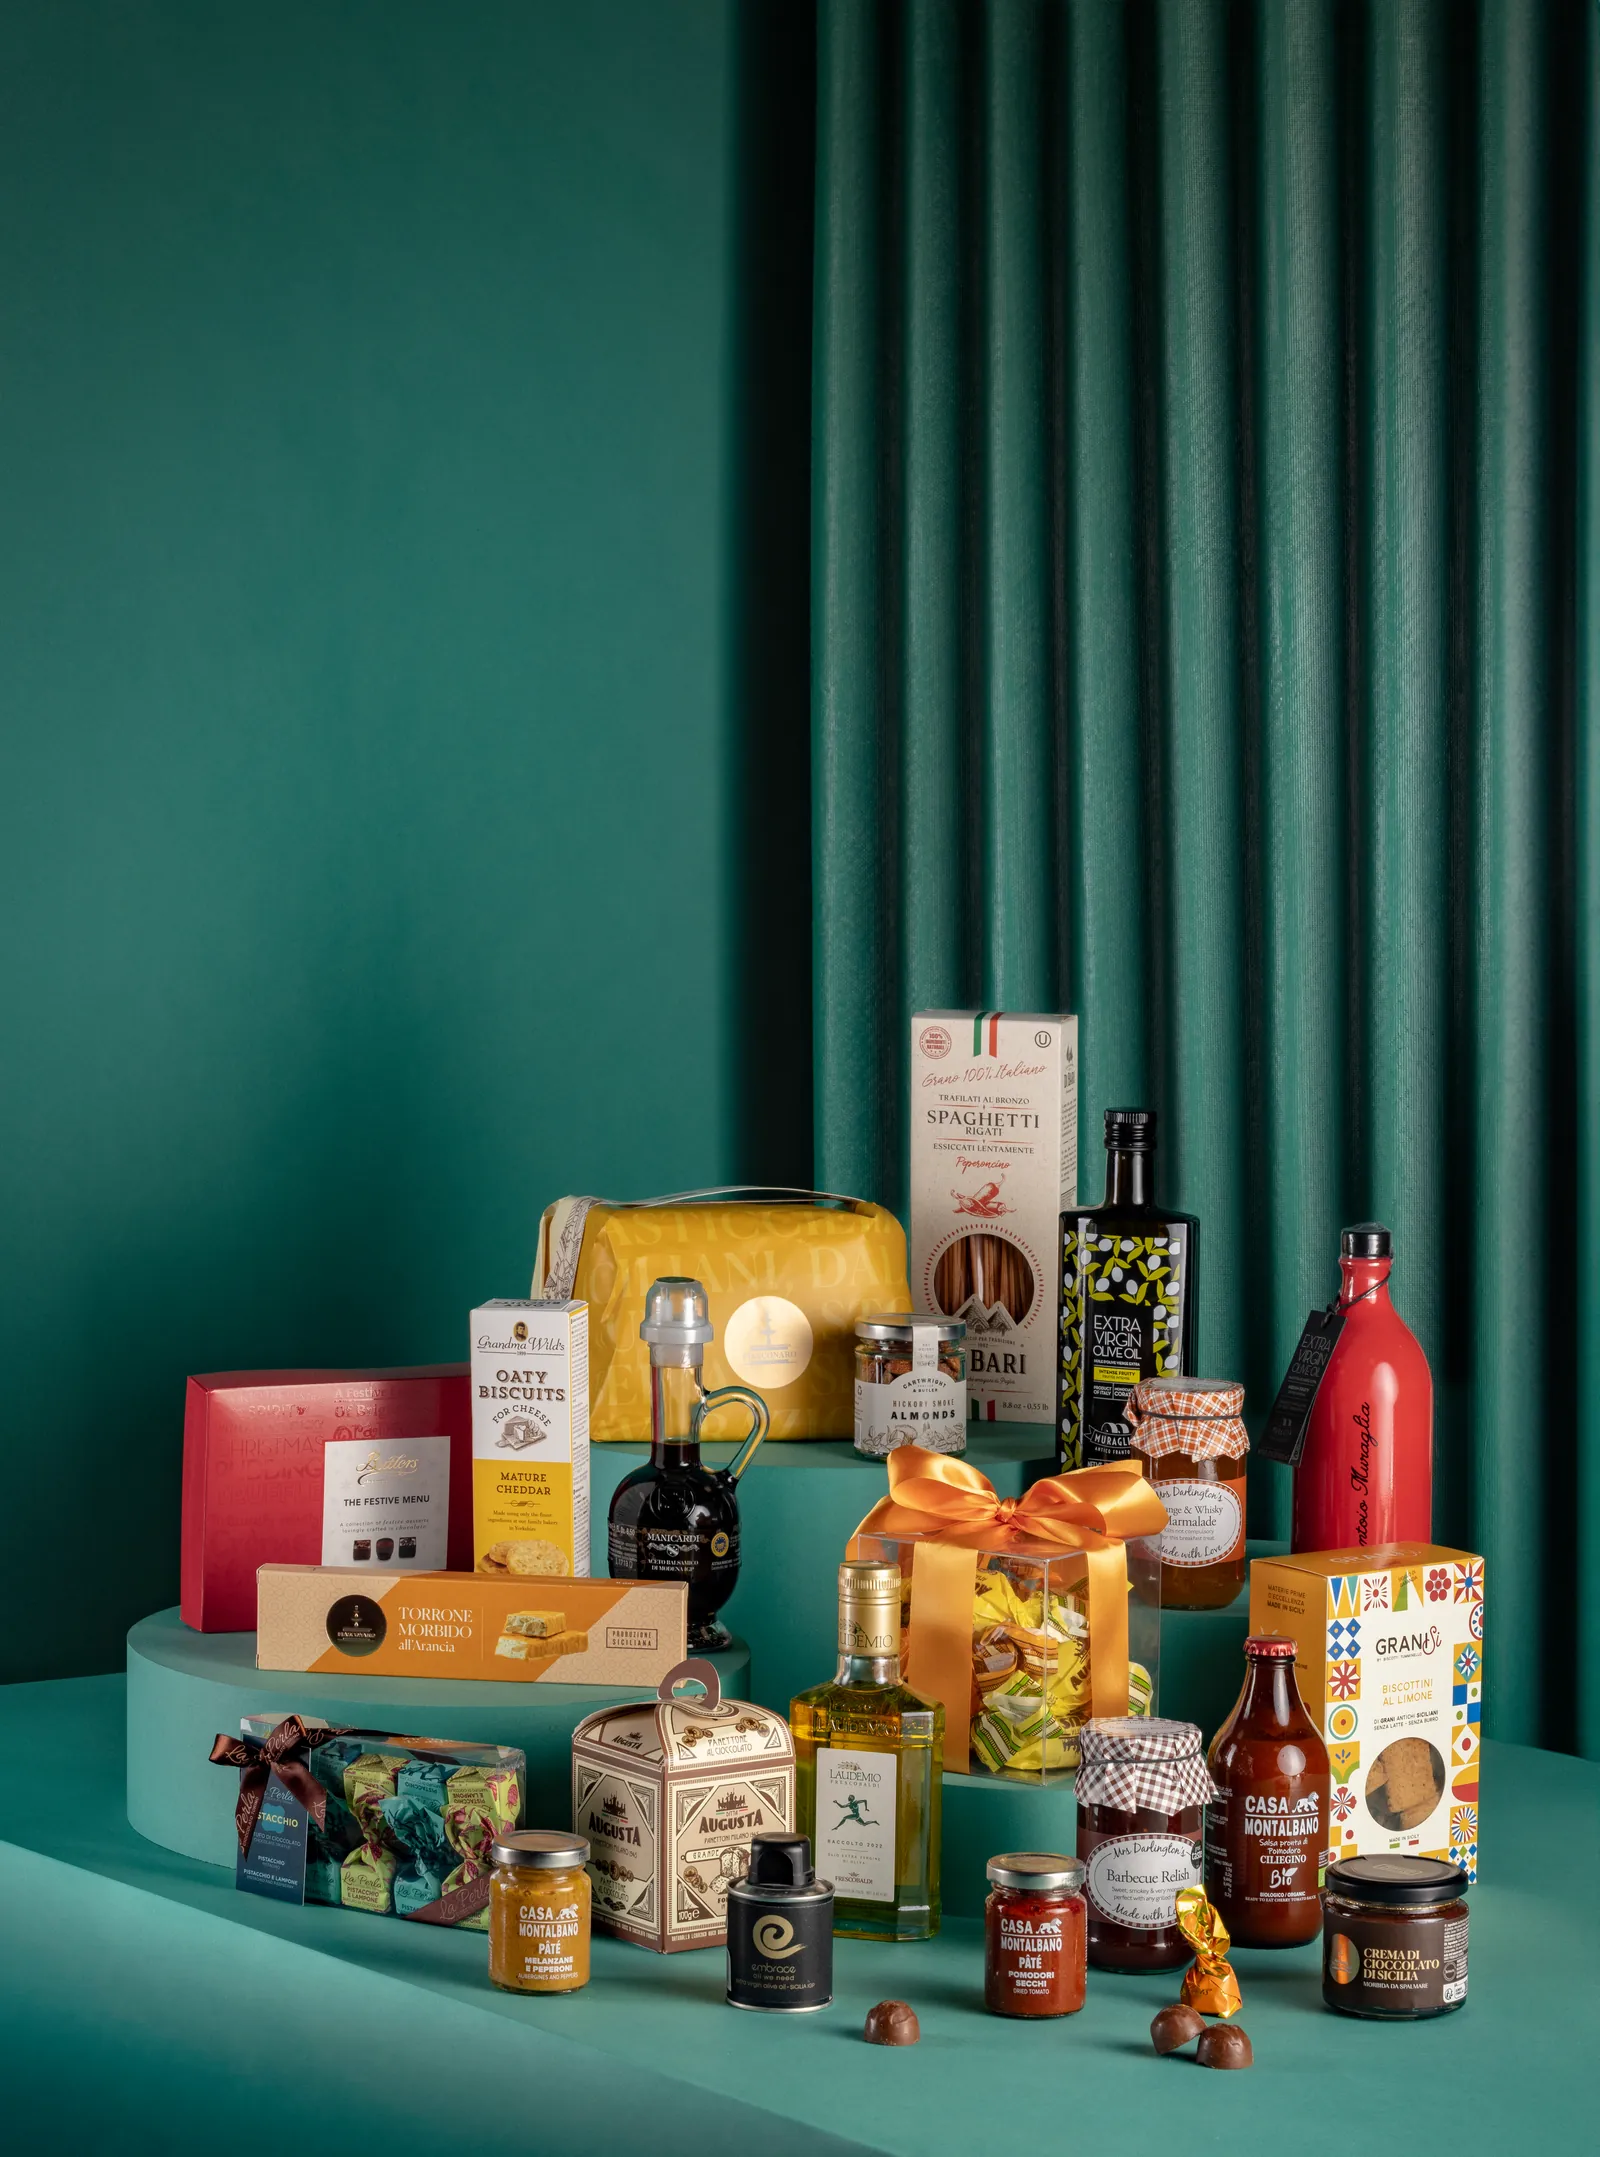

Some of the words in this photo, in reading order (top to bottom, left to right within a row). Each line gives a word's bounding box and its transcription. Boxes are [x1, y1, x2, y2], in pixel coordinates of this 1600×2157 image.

[922, 1073, 960, 1087] Grano
[963, 1067, 993, 1082] 100%
[994, 1061, 1047, 1078] Italiano
[939, 1094, 981, 1103] TRAFILATI
[995, 1096, 1030, 1105] BRONZO
[927, 1110, 1040, 1129] SPAGHETTI
[965, 1127, 1002, 1136] RIGATI
[933, 1143, 976, 1152] ESSICCATI
[977, 1144, 1034, 1154] LENTAMENTE
[956, 1156, 1011, 1174] Peperoncino
[1094, 1315, 1141, 1332] EXTRA
[477, 1335, 527, 1350] Grandma
[528, 1337, 565, 1351] Wild's
[1095, 1330, 1141, 1347] VIRGIN
[1302, 1334, 1332, 1352] EXTRA
[1093, 1345, 1123, 1358] OLIVE
[1124, 1348, 1142, 1359] OIL
[1298, 1349, 1328, 1366] VIRGIN
[971, 1350, 1026, 1374] BARI
[496, 1370, 548, 1384] OATY
[903, 1378, 946, 1389] CARTWRIGHT
[479, 1386, 566, 1401] BISCUITS
[893, 1400, 928, 1408] HICKORY
[492, 1407, 510, 1424] FOR
[512, 1404, 552, 1426] CHEESE
[891, 1410, 955, 1420] ALMONDS
[1095, 1433, 1130, 1446] MURAGLI
[1351, 1402, 1378, 1496] Muraglia
[356, 1451, 419, 1472] Butlers
[500, 1472, 547, 1482] MATURE
[496, 1485, 551, 1495] CHEDDAR
[1173, 1485, 1222, 1502] Darlington's
[364, 1497, 399, 1505] FESTIVE
[403, 1495, 430, 1503] MENU
[1166, 1507, 1182, 1516] ange
[1184, 1506, 1192, 1514] &
[1195, 1505, 1223, 1515] Whisky
[1355, 1500, 1368, 1546] ntoio
[648, 1533, 700, 1542] MANICARDI
[1155, 1545, 1179, 1557] Made
[1181, 1547, 1202, 1558] with
[1204, 1545, 1222, 1557] Love
[1268, 1584, 1289, 1595] MATERIE
[1290, 1589, 1305, 1598] PRIME
[1268, 1593, 1304, 1606] D'ECCELLENZA
[1267, 1601, 1281, 1609] MADE
[1289, 1605, 1305, 1614] SICILY
[398, 1607, 472, 1623] TORRONE
[398, 1623, 472, 1638] MORBIDO
[398, 1639, 455, 1653] all'Arancia
[840, 1632, 892, 1648] UDEMIO
[1383, 1679, 1433, 1694] BISCOTTINI
[1383, 1698, 1394, 1706] AL
[1398, 1691, 1432, 1704] LIMONE
[1417, 1710, 1438, 1718] SICILIANI
[265, 1722, 300, 1754] Perla
[611, 1735, 643, 1750] AUGUSTA
[708, 1735, 747, 1746] PANETTONE
[715, 1744, 752, 1755] CIOCCOLATO
[830, 1769, 881, 1782] LAUDEMIO
[405, 1782, 437, 1793] PISTACCHIO
[830, 1780, 880, 1788] FRESCOBALDI
[270, 1787, 295, 1801] Perla
[1245, 1796, 1288, 1813] CASA
[236, 1790, 255, 1834] Perla
[258, 1811, 298, 1827] STACCHIO
[699, 1809, 763, 1834] AUGUSTA
[1245, 1817, 1318, 1836] MONTALBANO
[588, 1811, 641, 1847] AUGUSTA
[1280, 1839, 1301, 1847] pronta
[1303, 1837, 1308, 1845] di
[693, 1849, 719, 1859] GRANDE
[1112, 1846, 1131, 1859] Mrs
[1133, 1840, 1186, 1857] Darlington's
[1268, 1847, 1301, 1855] Pomodoro
[258, 1856, 285, 1866] PISTACCHIO
[1260, 1855, 1306, 1864] CILIEGINO
[244, 1869, 270, 1879] PISTACCHIO
[275, 1876, 298, 1885] LAMPONE
[342, 1872, 356, 1883] La
[358, 1874, 382, 1888] Perla
[835, 1876, 873, 1884] FRESCOBALDI
[1106, 1869, 1158, 1884] Barbecue
[1161, 1868, 1190, 1882] Relish
[1269, 1868, 1292, 1888] Bio
[347, 1887, 379, 1898] PISTACCHIO
[520, 1905, 553, 1920] CASA
[1112, 1903, 1140, 1920] Made
[1143, 1908, 1164, 1920] with
[520, 1923, 578, 1937] MONTALBANO
[1001, 1918, 1033, 1934] CASA
[539, 1940, 560, 1954] PÂTÉ
[1001, 1936, 1062, 1952] MONTALBANO
[525, 1956, 573, 1964] MELANZANE
[1019, 1954, 1042, 1968] PÂTÉ
[1364, 1948, 1405, 1960] CREMA
[1407, 1950, 1420, 1960] DI
[752, 1963, 796, 1973] embrace
[1364, 1959, 1439, 1972] CIOCCOLATO
[1364, 1968, 1375, 1979] DI
[1377, 1970, 1418, 1980] SICILIA
